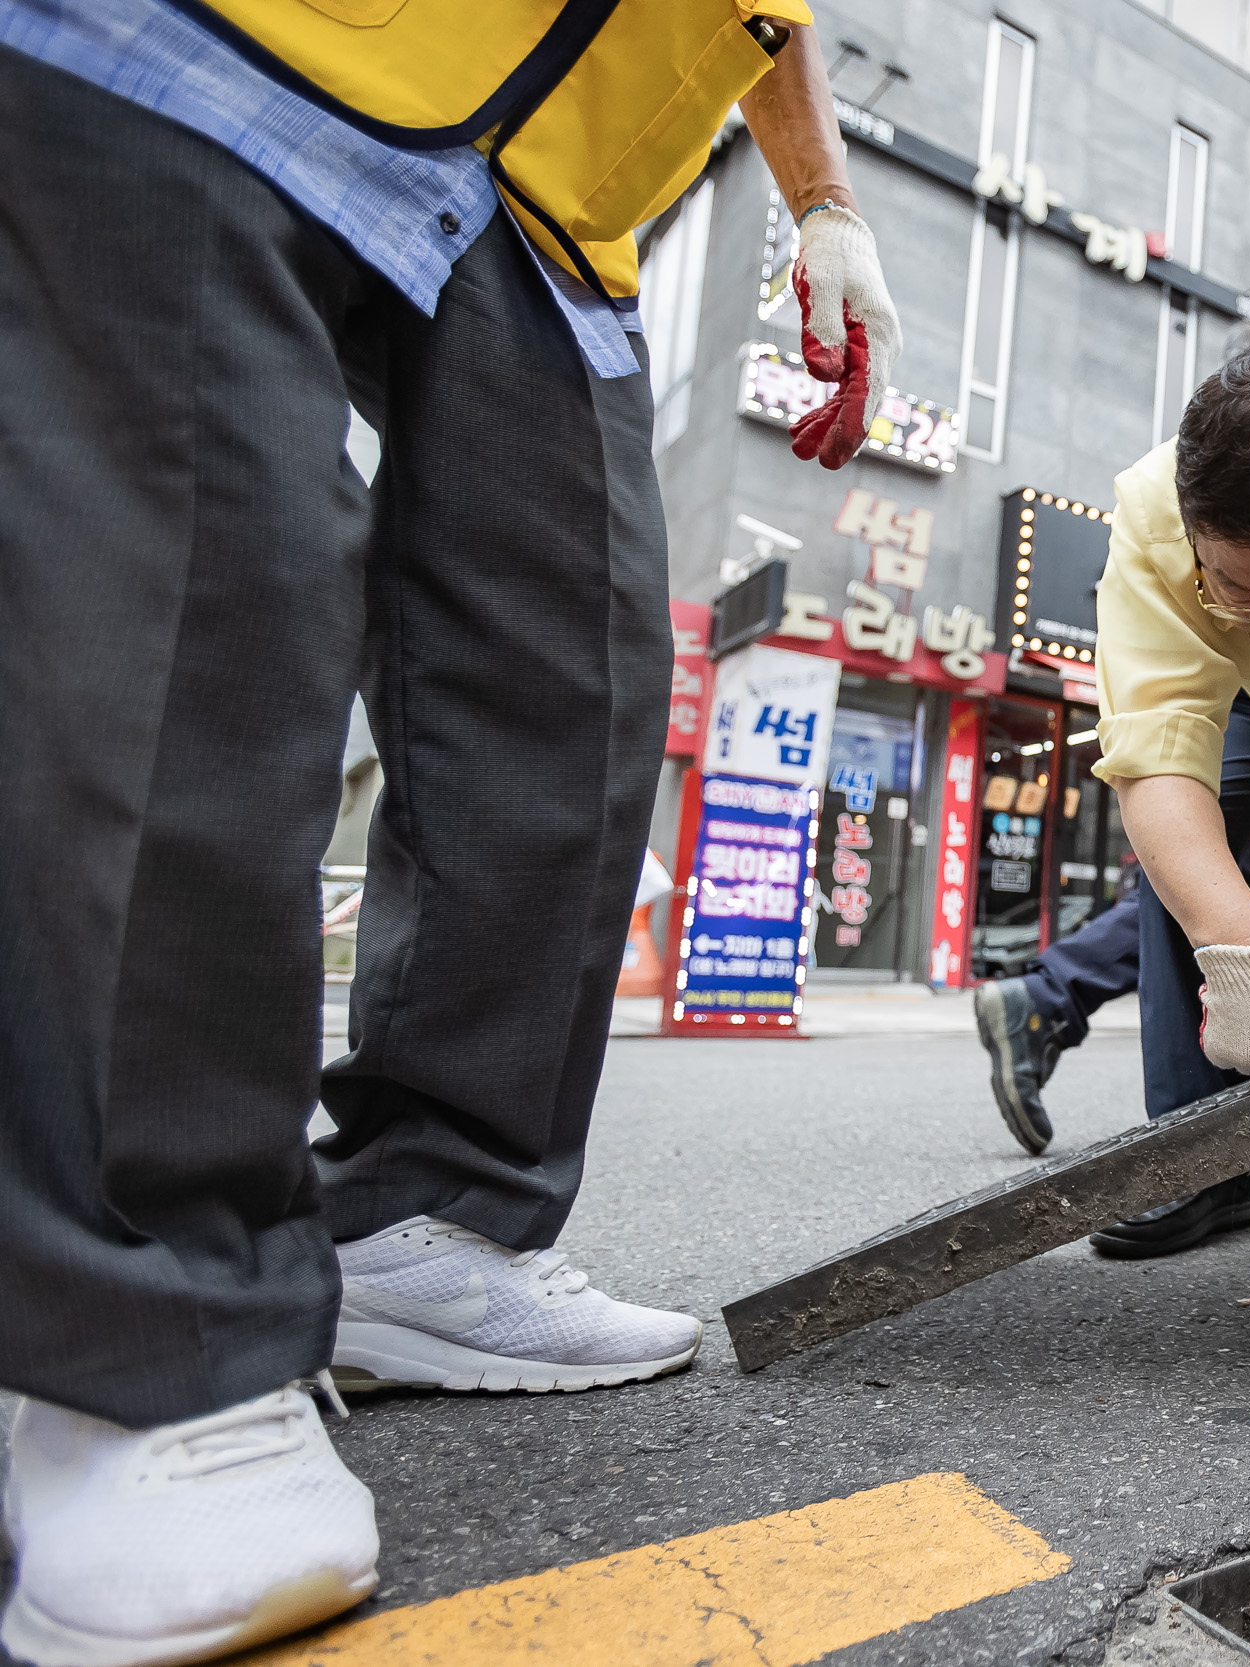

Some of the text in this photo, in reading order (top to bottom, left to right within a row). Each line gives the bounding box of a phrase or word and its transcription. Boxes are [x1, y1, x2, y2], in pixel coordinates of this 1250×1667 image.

[906, 409, 955, 462] 24
[834, 489, 934, 589] 썸
[780, 579, 996, 679] 노래방
[754, 706, 817, 767] 썸
[831, 764, 878, 813] 썸
[832, 812, 873, 924] 노래방
